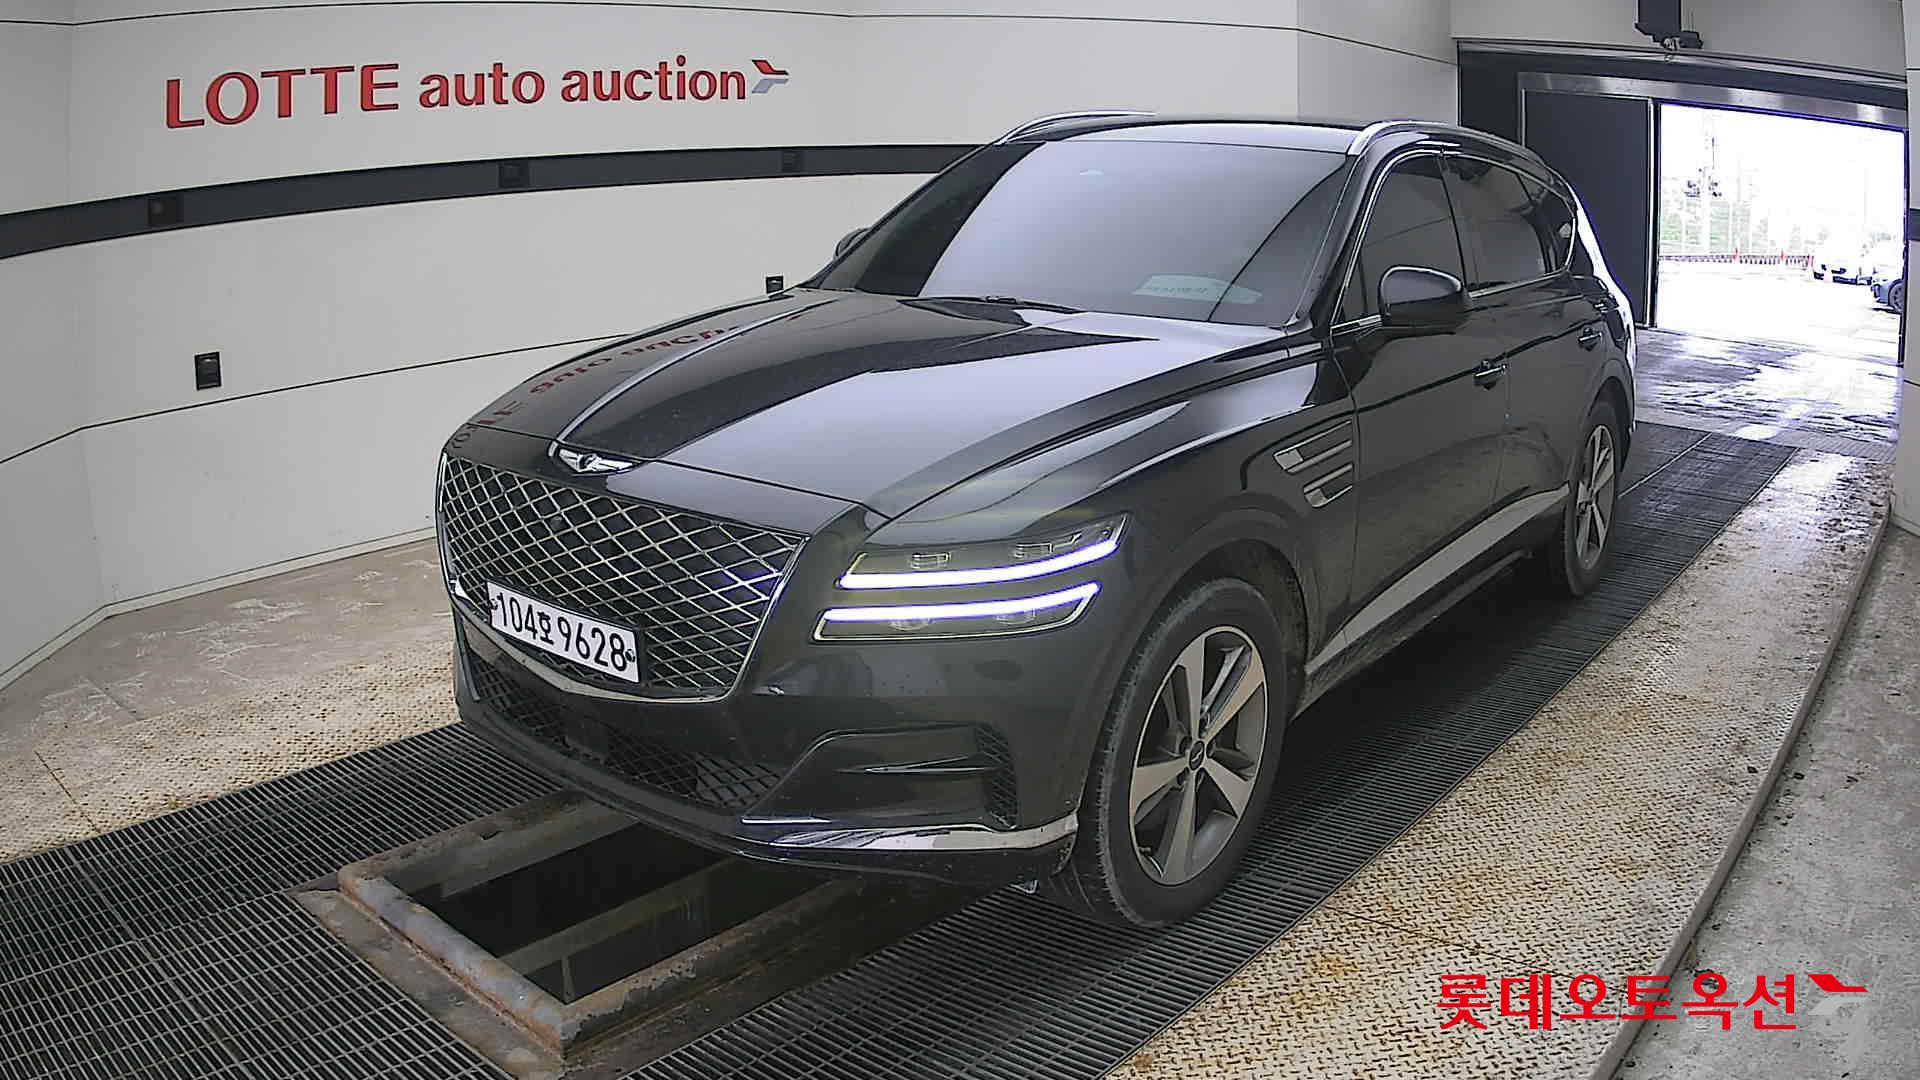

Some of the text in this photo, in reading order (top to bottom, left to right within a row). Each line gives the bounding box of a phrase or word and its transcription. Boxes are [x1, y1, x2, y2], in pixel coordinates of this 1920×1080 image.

[166, 55, 748, 129] LOTTE auto auction
